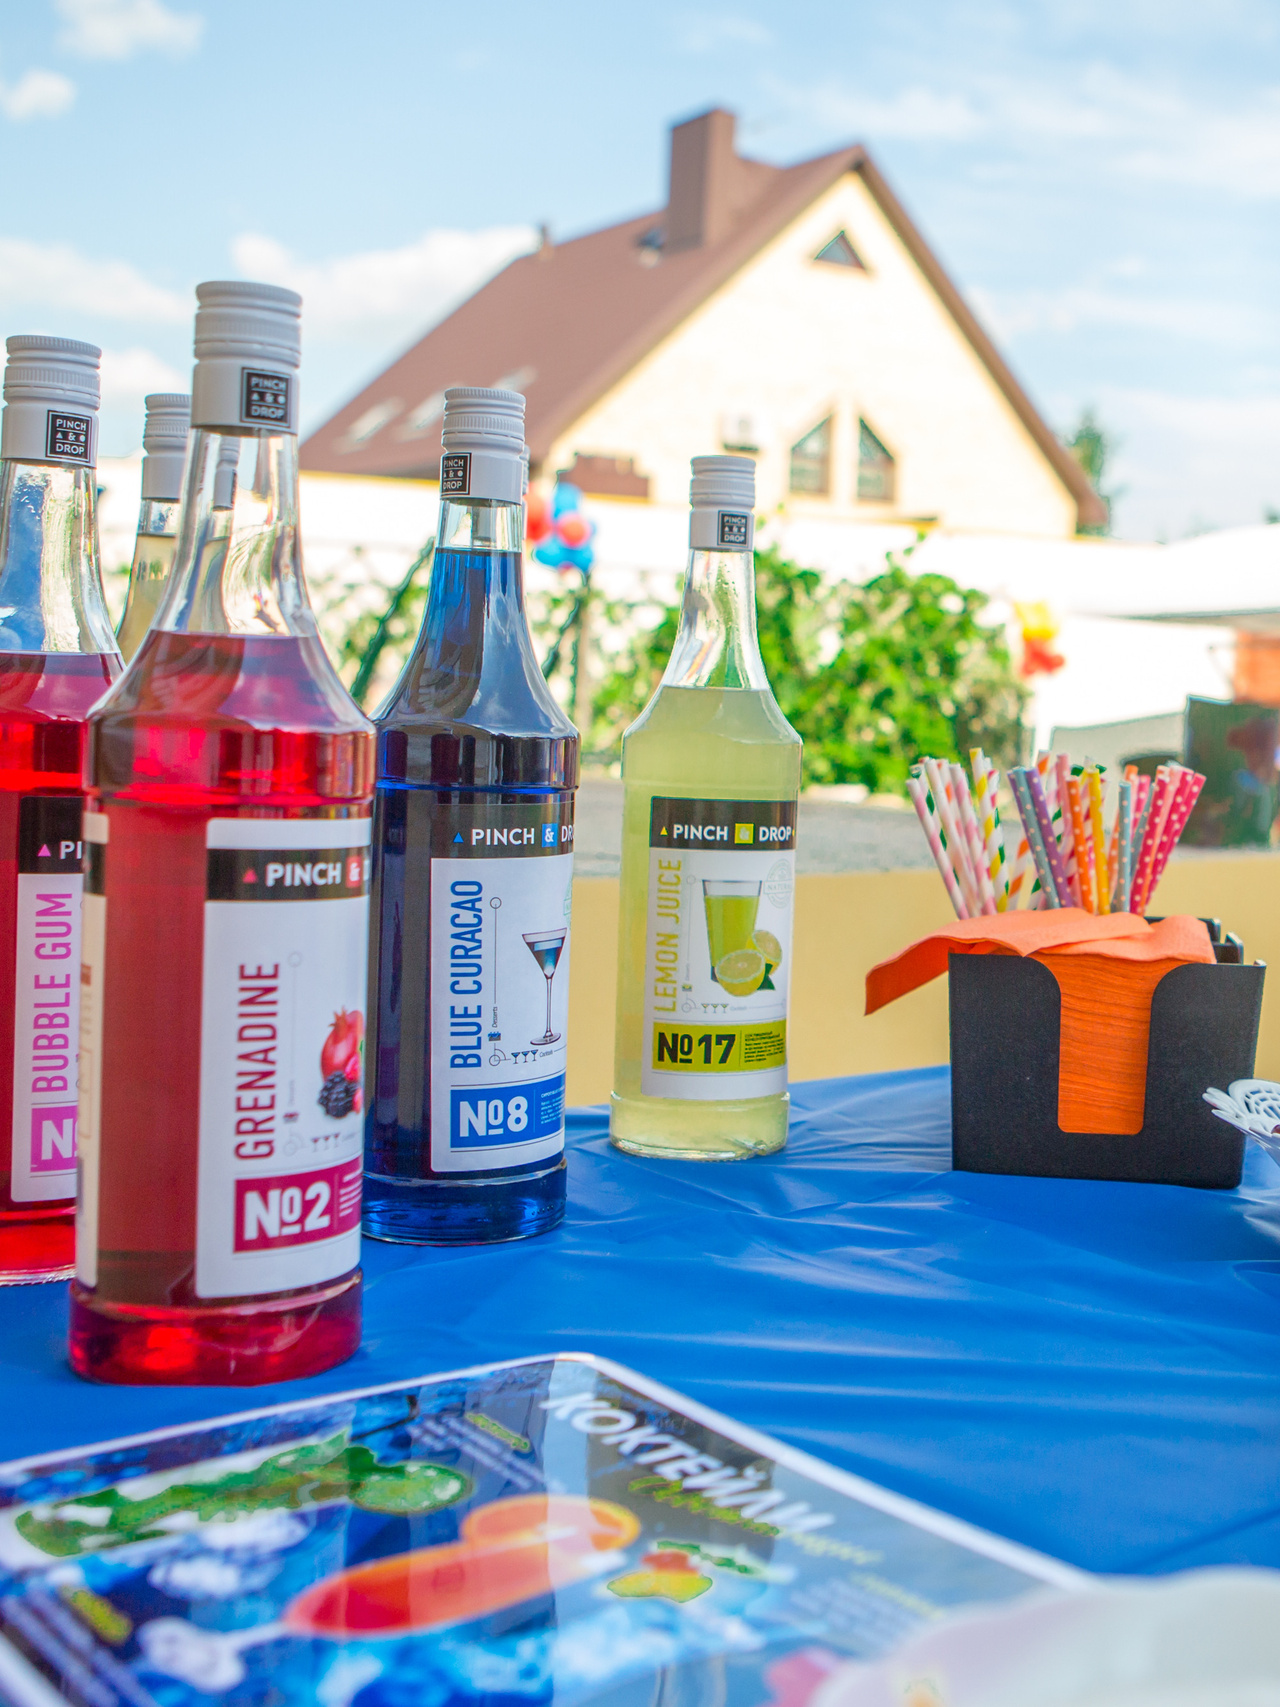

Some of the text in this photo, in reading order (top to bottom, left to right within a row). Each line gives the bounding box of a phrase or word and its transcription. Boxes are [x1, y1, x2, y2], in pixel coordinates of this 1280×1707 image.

[251, 376, 287, 391] PINCH
[265, 392, 274, 403] &
[251, 405, 285, 418] DROP
[56, 418, 87, 431] PINCH
[68, 432, 76, 441] &
[56, 443, 85, 455] DROP
[443, 459, 464, 468] PINCH
[443, 480, 463, 490] DROP
[724, 515, 746, 525] PINCH
[724, 534, 745, 542] DROP
[472, 824, 574, 846] PINCH & DR
[673, 823, 729, 841] PINCH
[758, 825, 792, 842] DROP
[265, 861, 343, 887] PINCH
[349, 862, 360, 881] &
[654, 858, 682, 1013] LEMON JUICE
[450, 880, 483, 1069] BLUE CURACAO
[31, 893, 73, 1093] BUBBLE GUM
[234, 963, 279, 1161] GRENADINE
